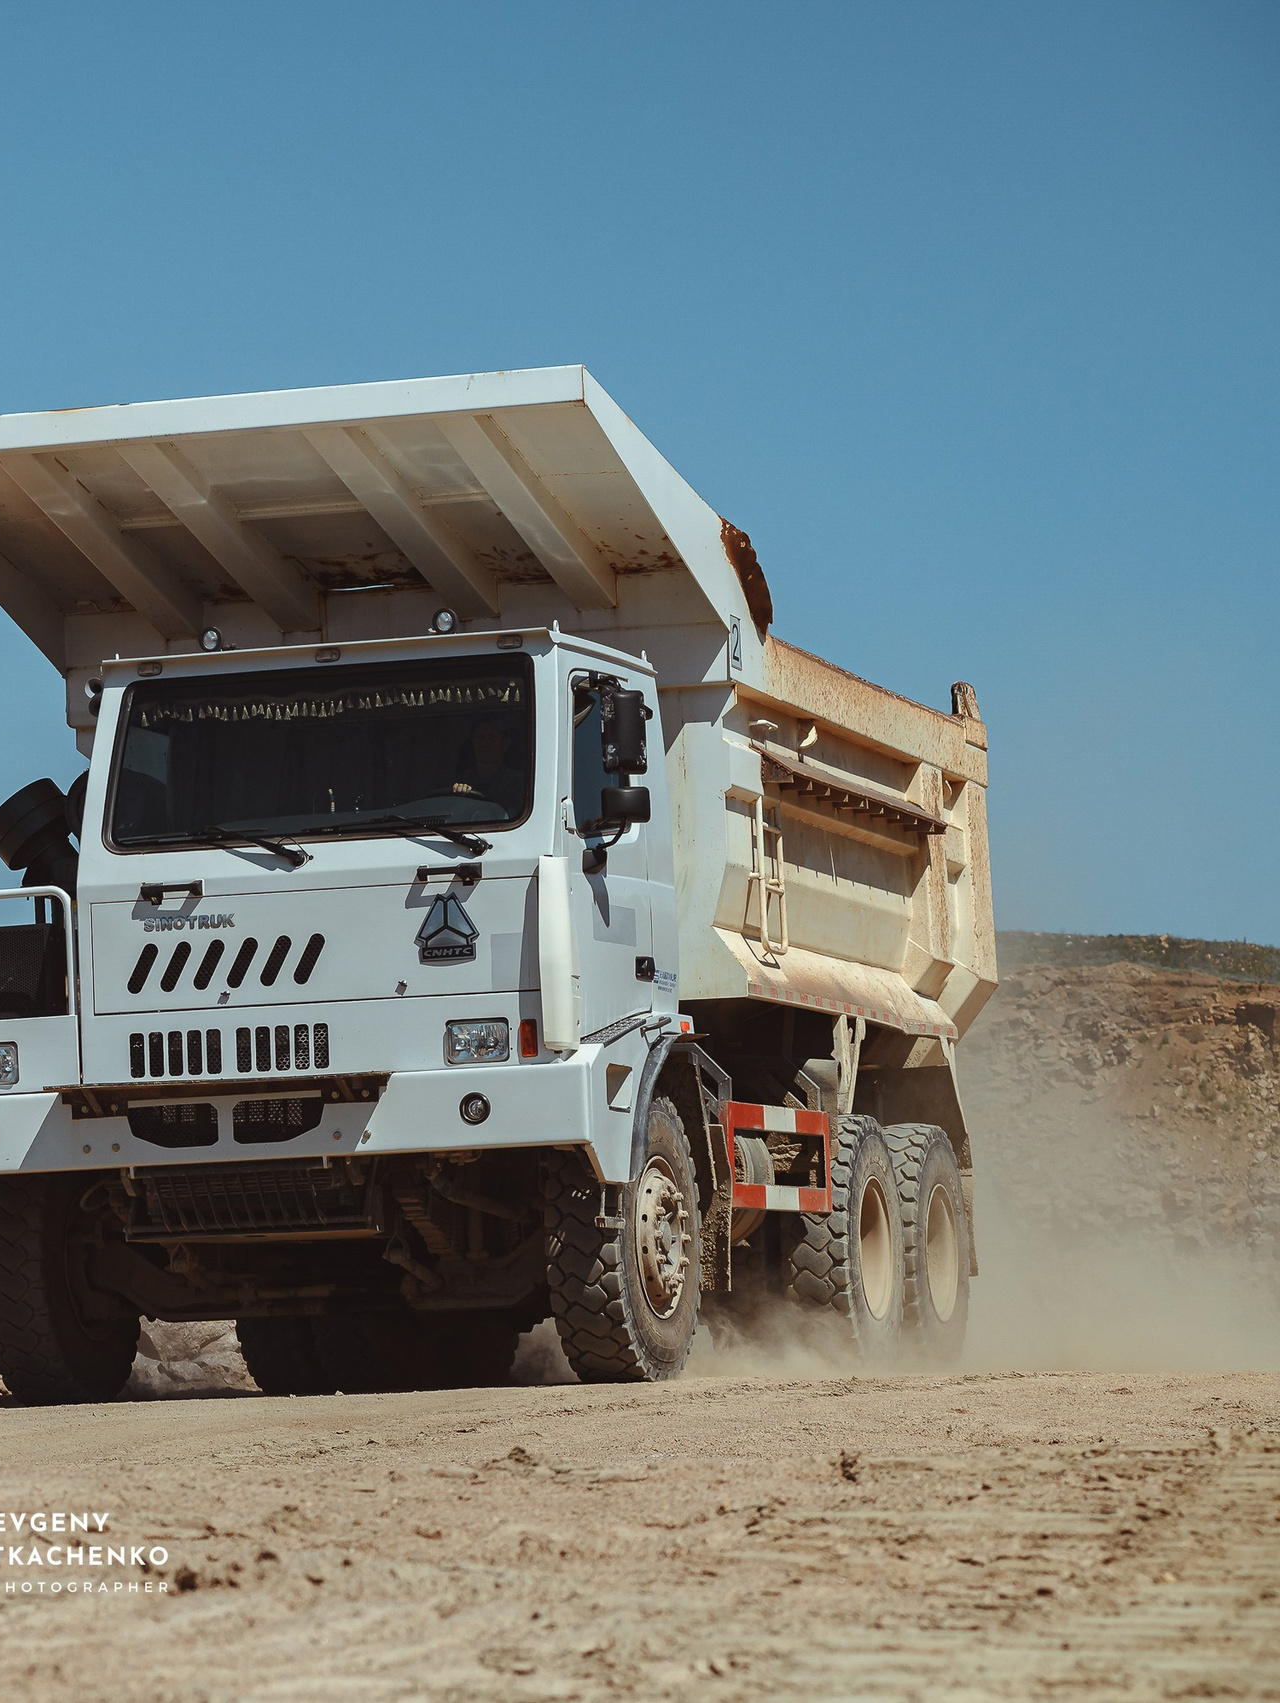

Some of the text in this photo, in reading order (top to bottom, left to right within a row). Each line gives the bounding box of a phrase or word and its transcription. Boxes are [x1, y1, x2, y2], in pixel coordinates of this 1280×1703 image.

[732, 623, 740, 662] 2
[143, 913, 236, 932] SINOTRUK
[423, 947, 472, 957] CNHTC
